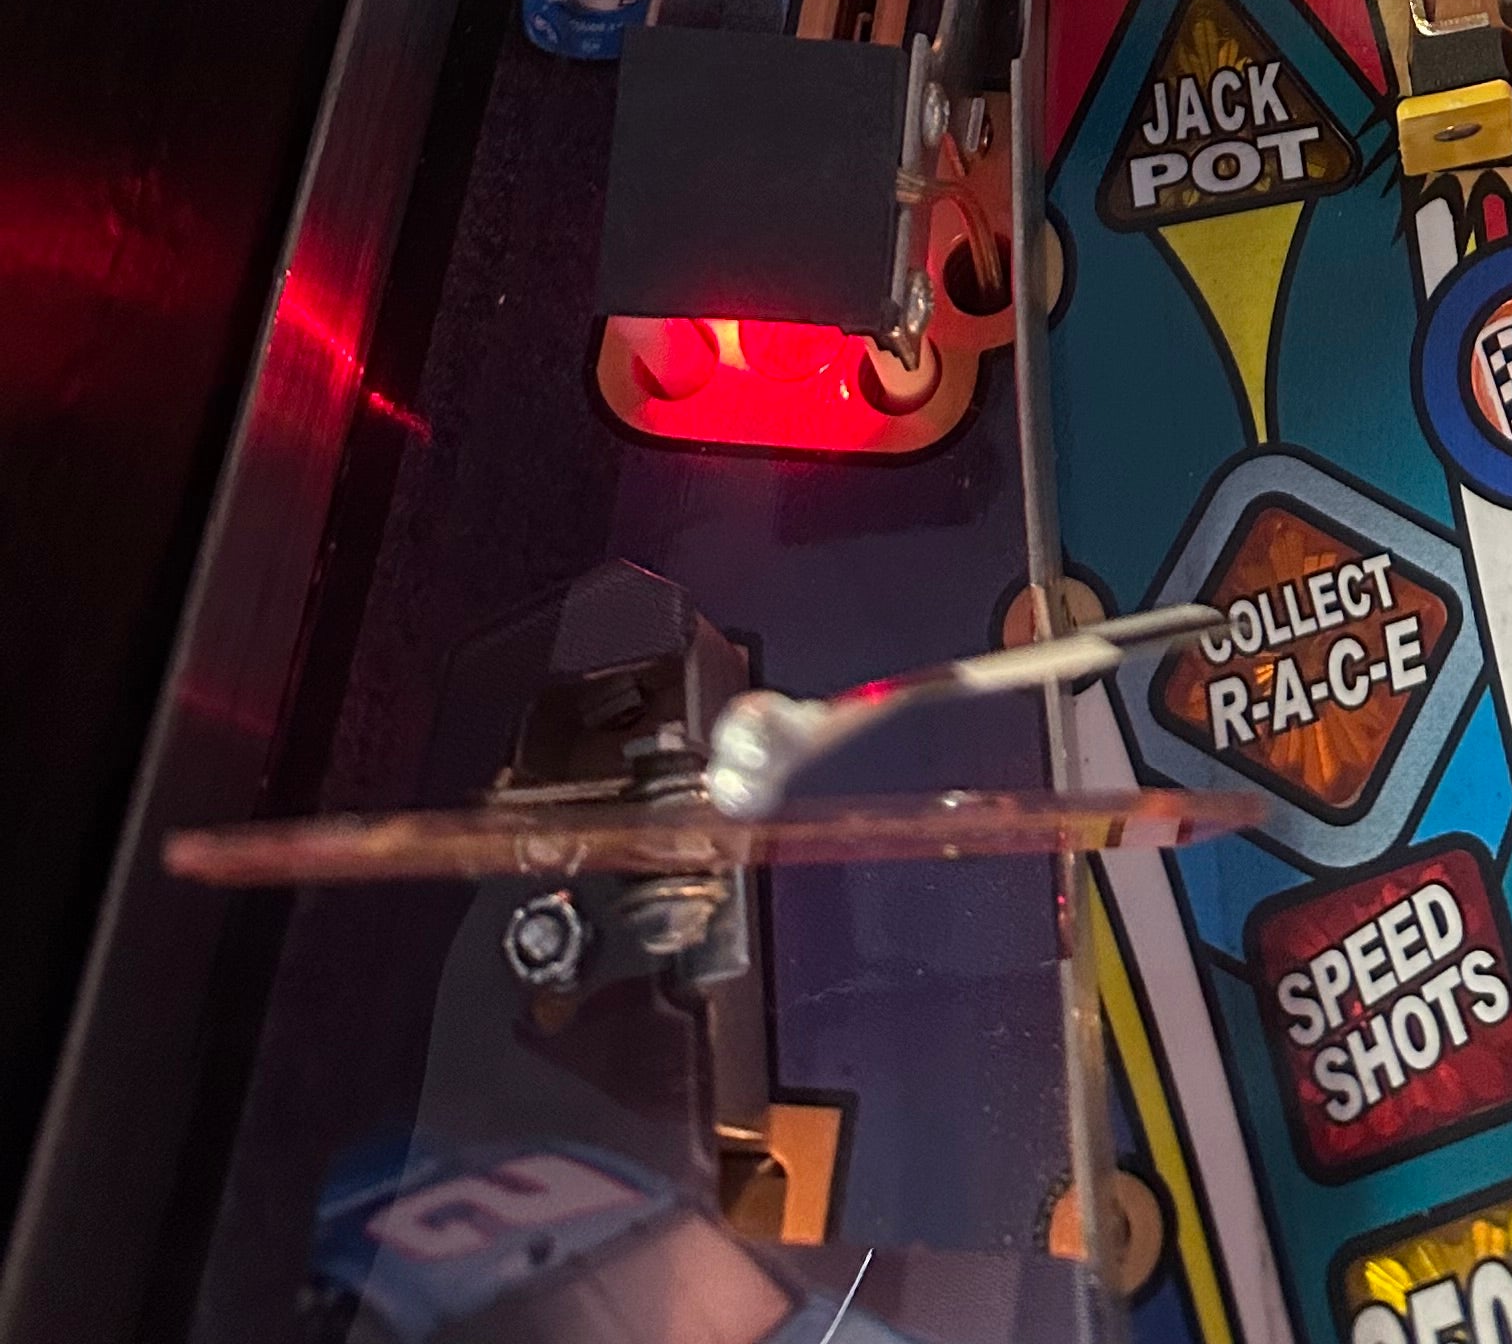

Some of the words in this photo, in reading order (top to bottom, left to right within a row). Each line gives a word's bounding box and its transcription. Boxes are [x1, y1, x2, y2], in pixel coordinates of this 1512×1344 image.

[1130, 126, 1320, 209] POT
[1143, 62, 1289, 147] JACK
[1208, 615, 1428, 750] R-A-C-E
[1278, 882, 1465, 1049] SPEED
[1314, 950, 1511, 1124] SHOTS
